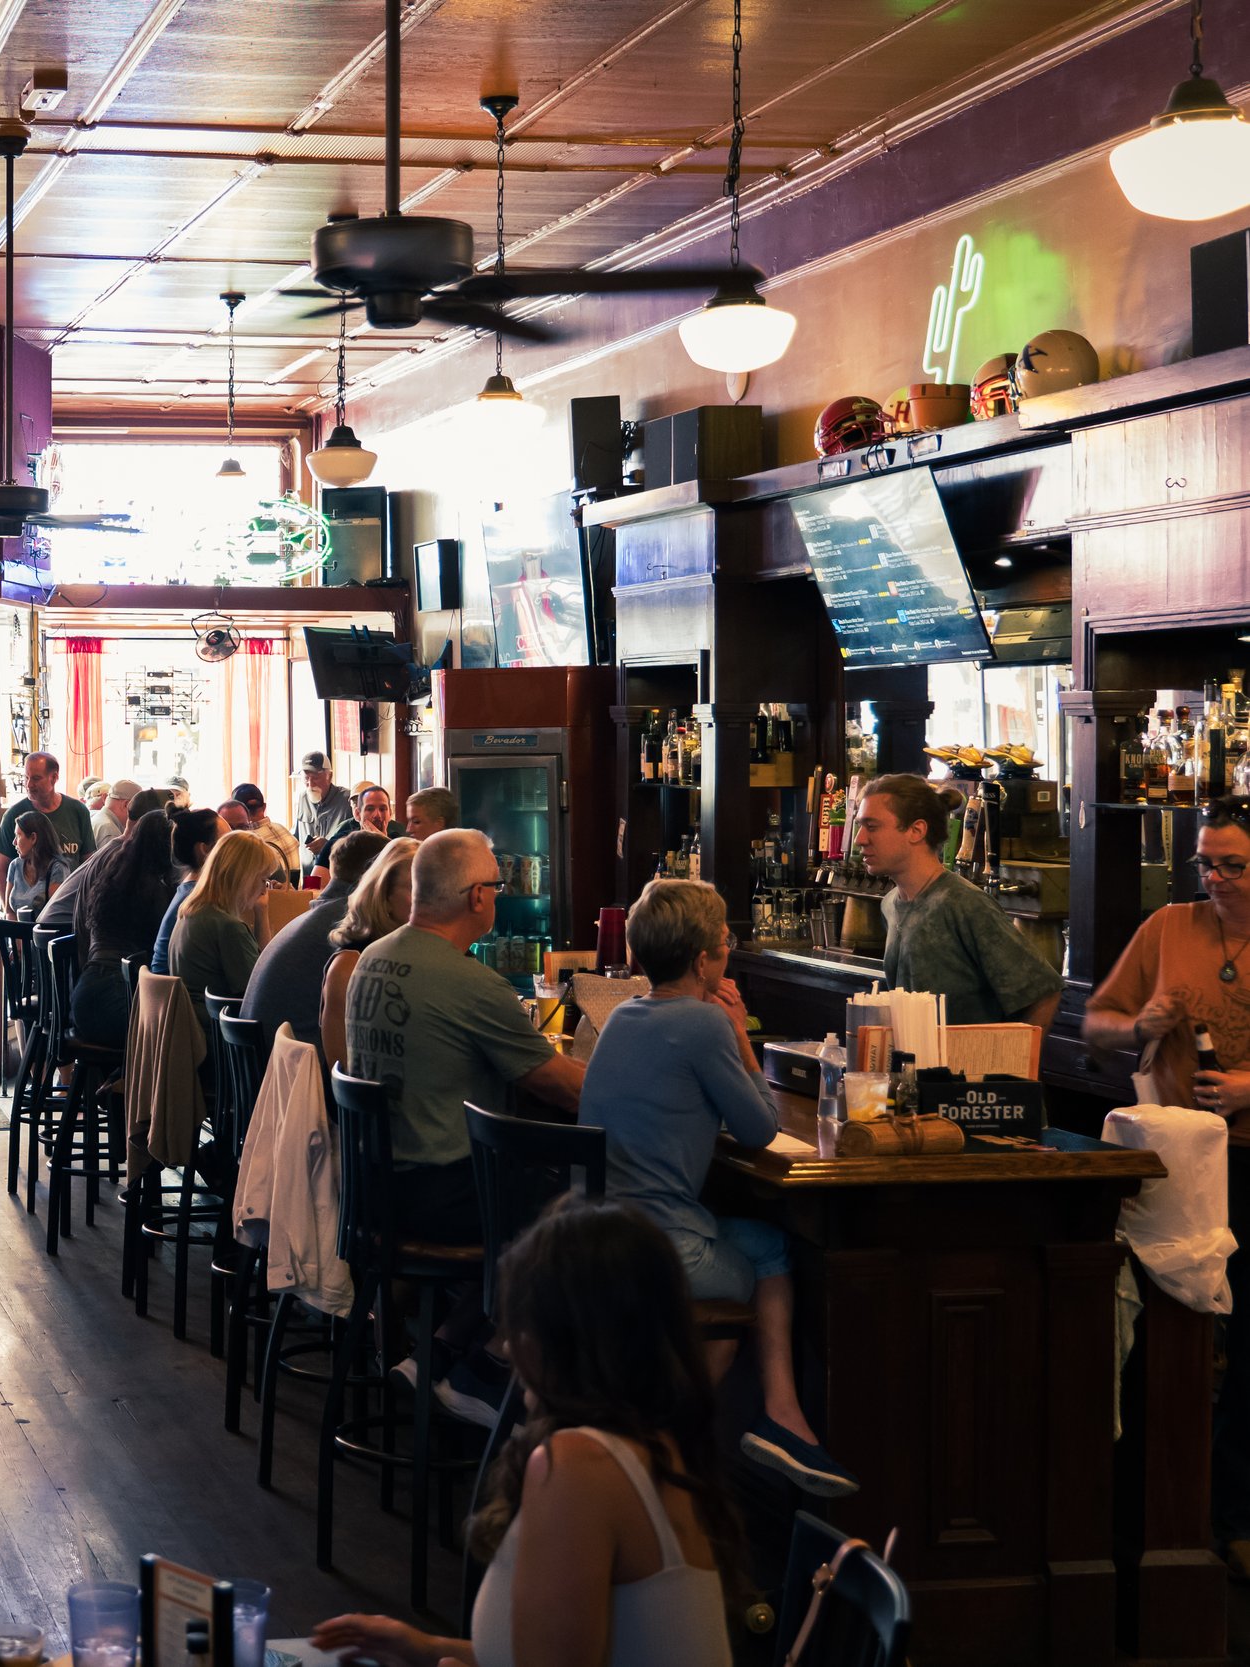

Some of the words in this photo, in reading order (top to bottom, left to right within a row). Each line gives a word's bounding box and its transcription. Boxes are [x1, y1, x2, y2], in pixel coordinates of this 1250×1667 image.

[895, 400, 911, 424] H
[484, 735, 526, 745] Bevador
[1125, 753, 1144, 765] KNO
[63, 842, 79, 854] ND
[348, 1023, 406, 1058] ISIONS
[965, 1089, 998, 1105] OLD
[937, 1103, 1025, 1121] FORESTER
